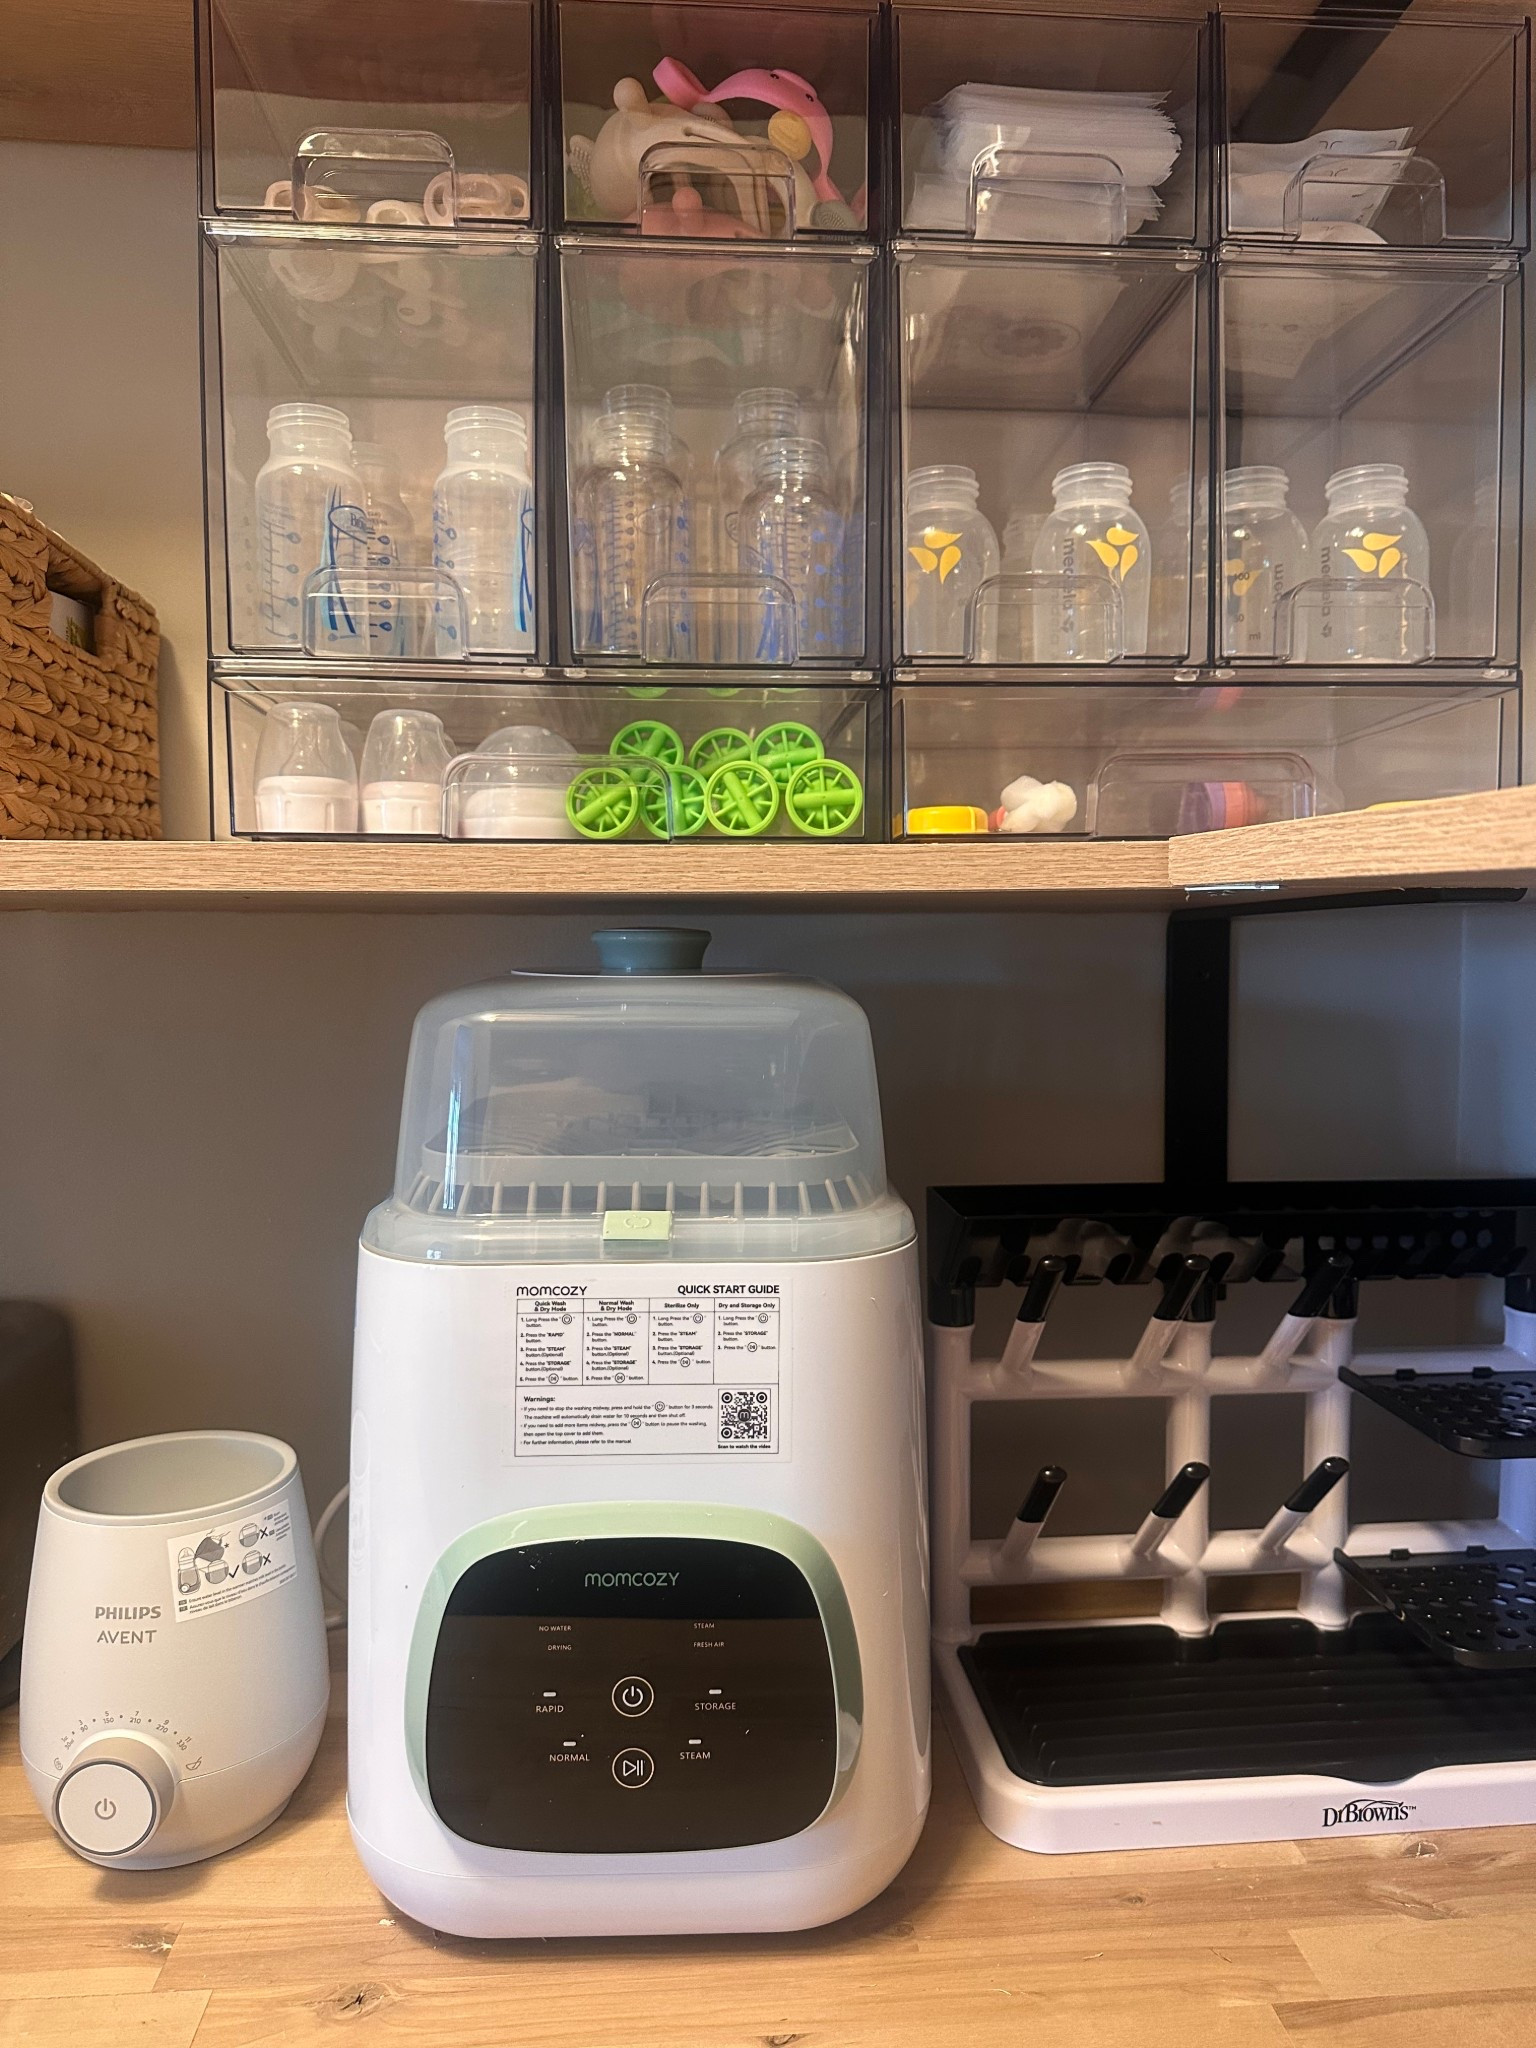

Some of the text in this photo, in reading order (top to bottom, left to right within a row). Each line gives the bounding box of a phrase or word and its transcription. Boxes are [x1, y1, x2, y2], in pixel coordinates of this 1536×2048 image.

[678, 1285, 779, 1294] QUICK START GUIDE
[95, 1606, 161, 1620] PHILIPS
[97, 1630, 157, 1644] AVENT
[695, 1703, 736, 1711] STORAGE
[156, 1724, 168, 1733] 270
[176, 1739, 187, 1751] 330
[550, 1754, 590, 1762] NORMAL
[680, 1752, 710, 1760] STEAM
